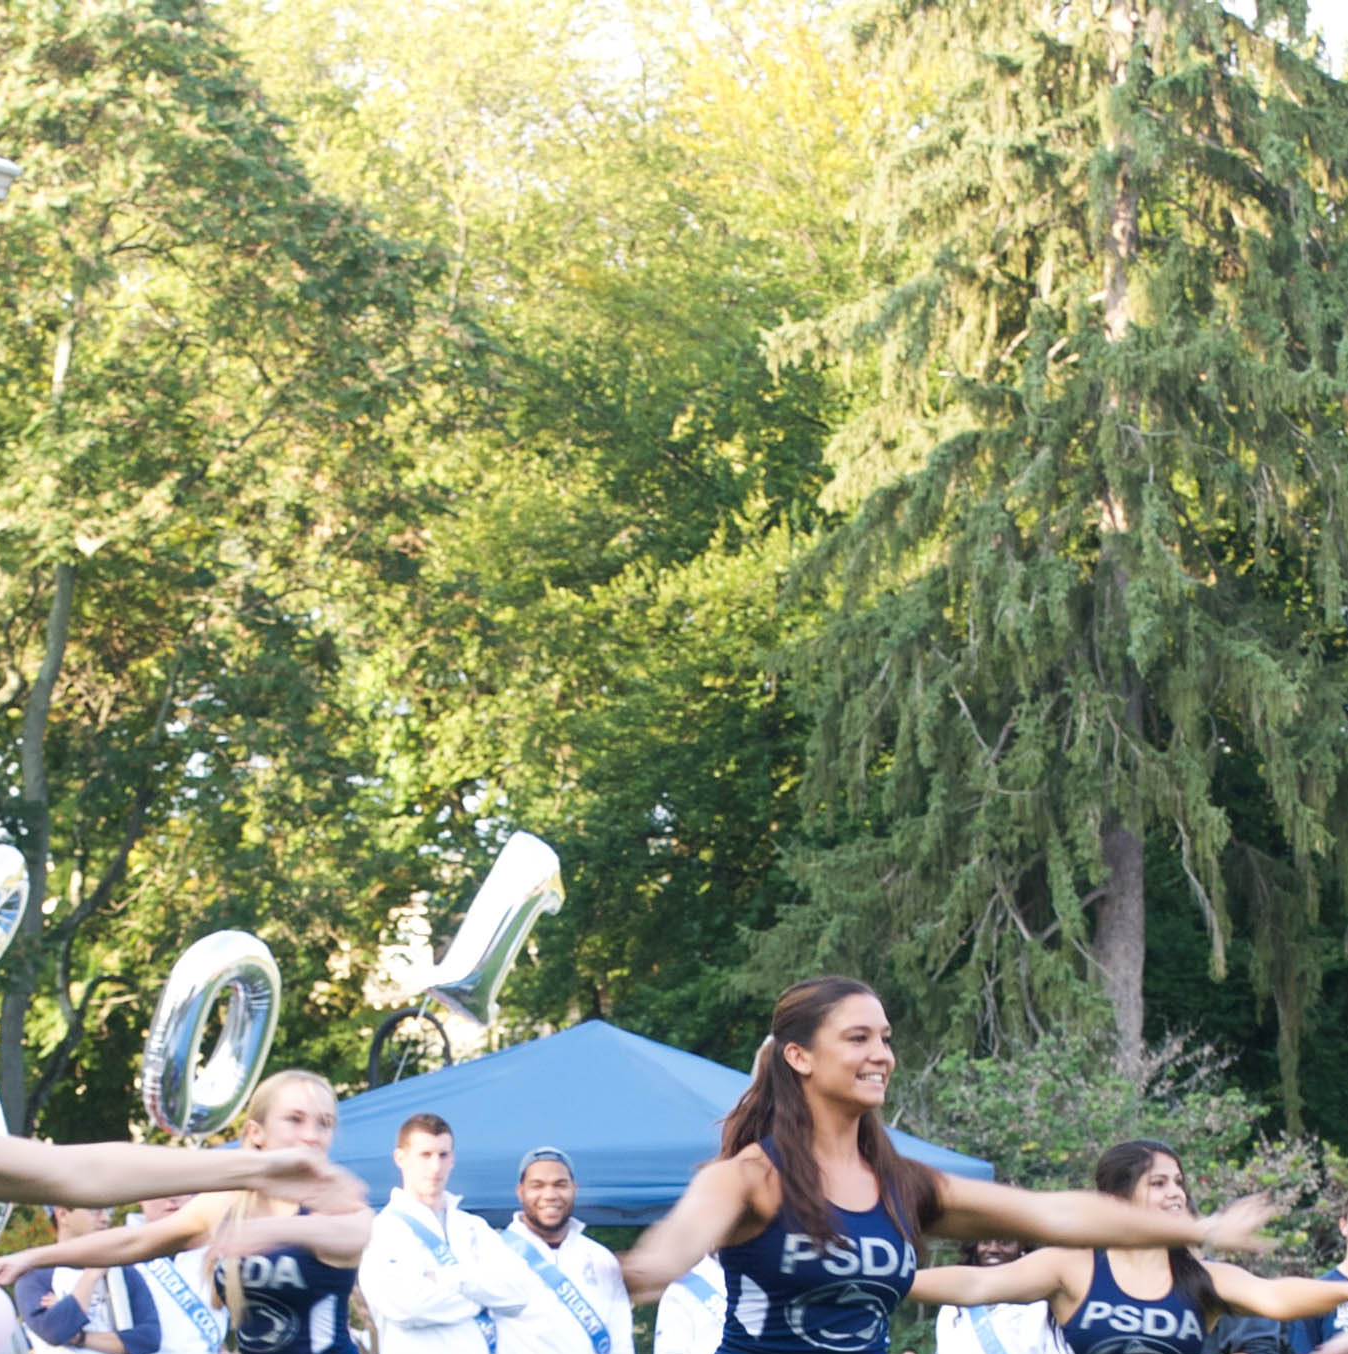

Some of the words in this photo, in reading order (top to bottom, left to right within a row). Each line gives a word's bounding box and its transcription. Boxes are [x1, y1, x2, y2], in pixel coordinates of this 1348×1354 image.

[780, 1233, 917, 1278] PSDA
[555, 1280, 602, 1336] STUDENT
[1079, 1300, 1202, 1341] PSDA
